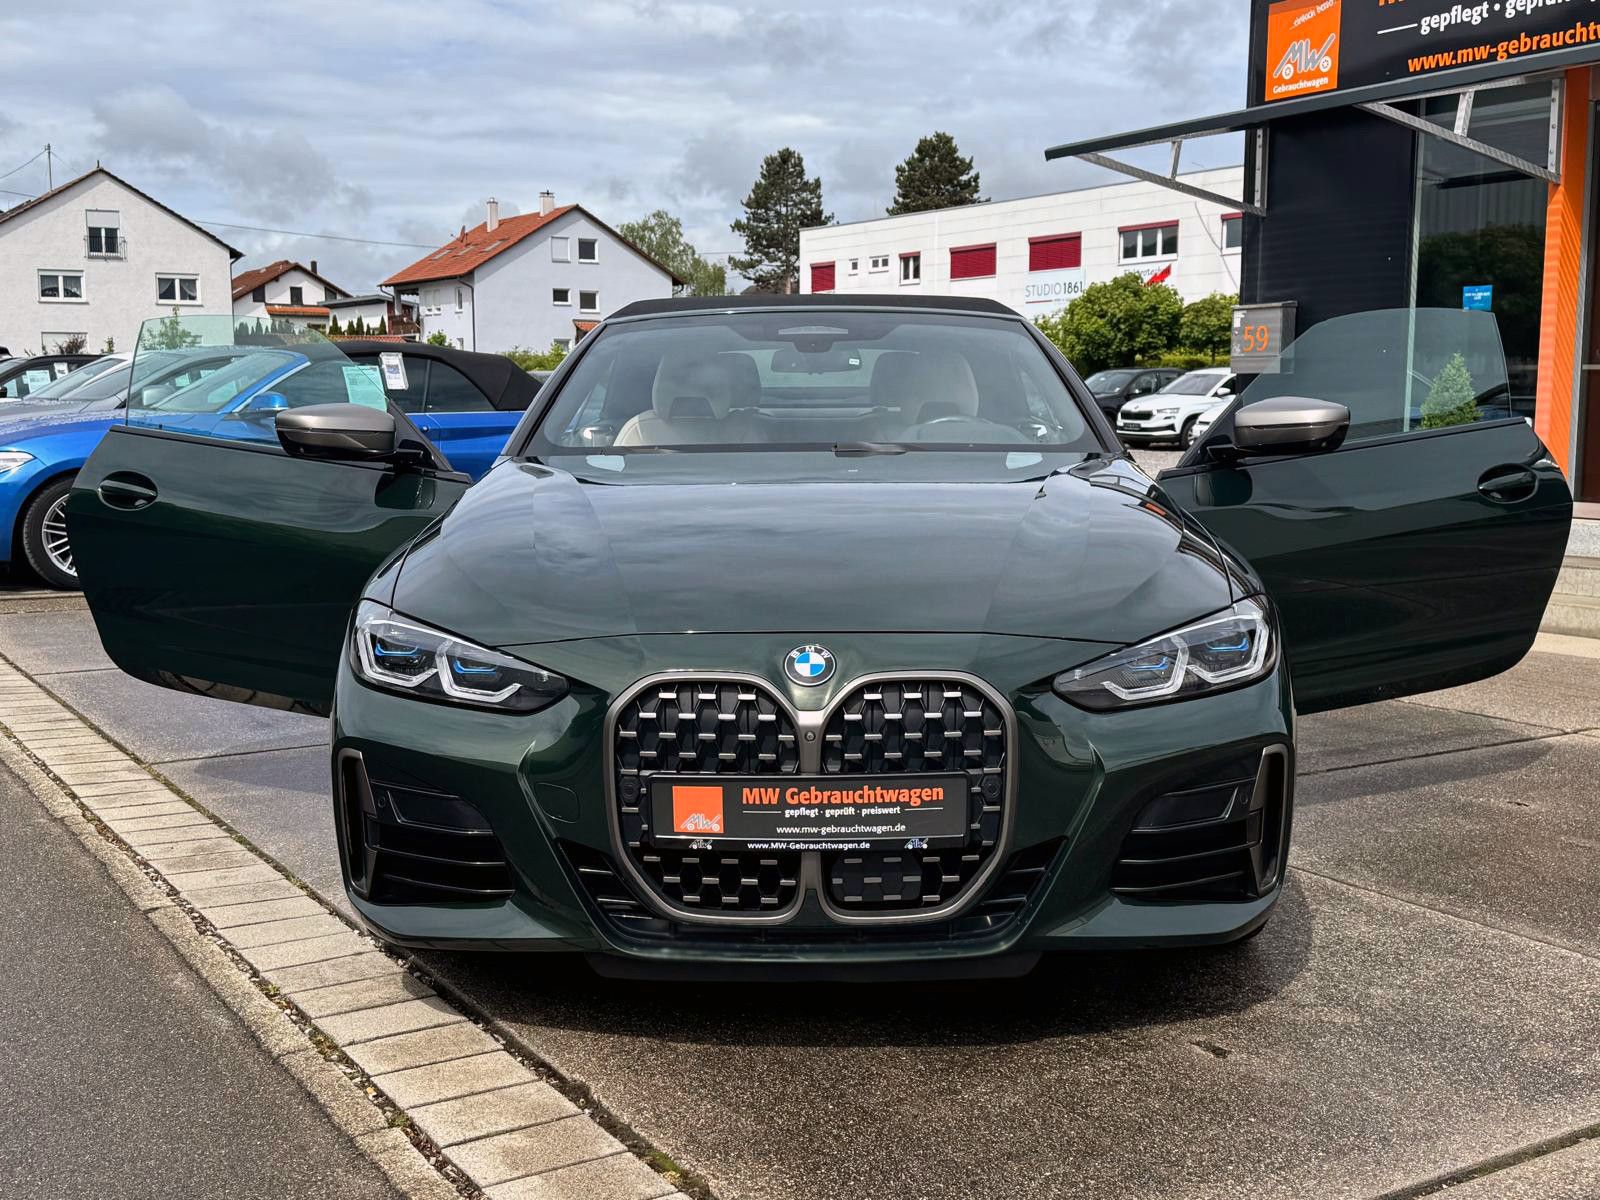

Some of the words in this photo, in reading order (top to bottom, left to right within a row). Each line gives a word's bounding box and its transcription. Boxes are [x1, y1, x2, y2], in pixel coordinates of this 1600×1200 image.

[1420, 1, 1489, 35] gepflegt
[1408, 21, 1600, 72] www.mw-gebraucht
[1273, 77, 1328, 94] Gebrauchtwagen
[1025, 282, 1062, 298] STUDIO
[1063, 281, 1083, 294] 1861
[1243, 325, 1269, 352] 59
[790, 645, 831, 659] BMW
[742, 787, 780, 805] MW
[785, 785, 944, 807] Gebrauchtwagen
[785, 806, 819, 818] gepflegt
[825, 806, 855, 818] geprüft
[861, 806, 901, 818] preiswert
[776, 823, 906, 835] www.mw-gebrauchtwagen.de
[747, 841, 871, 851] www.MW-Gebrauchtwagen.de
